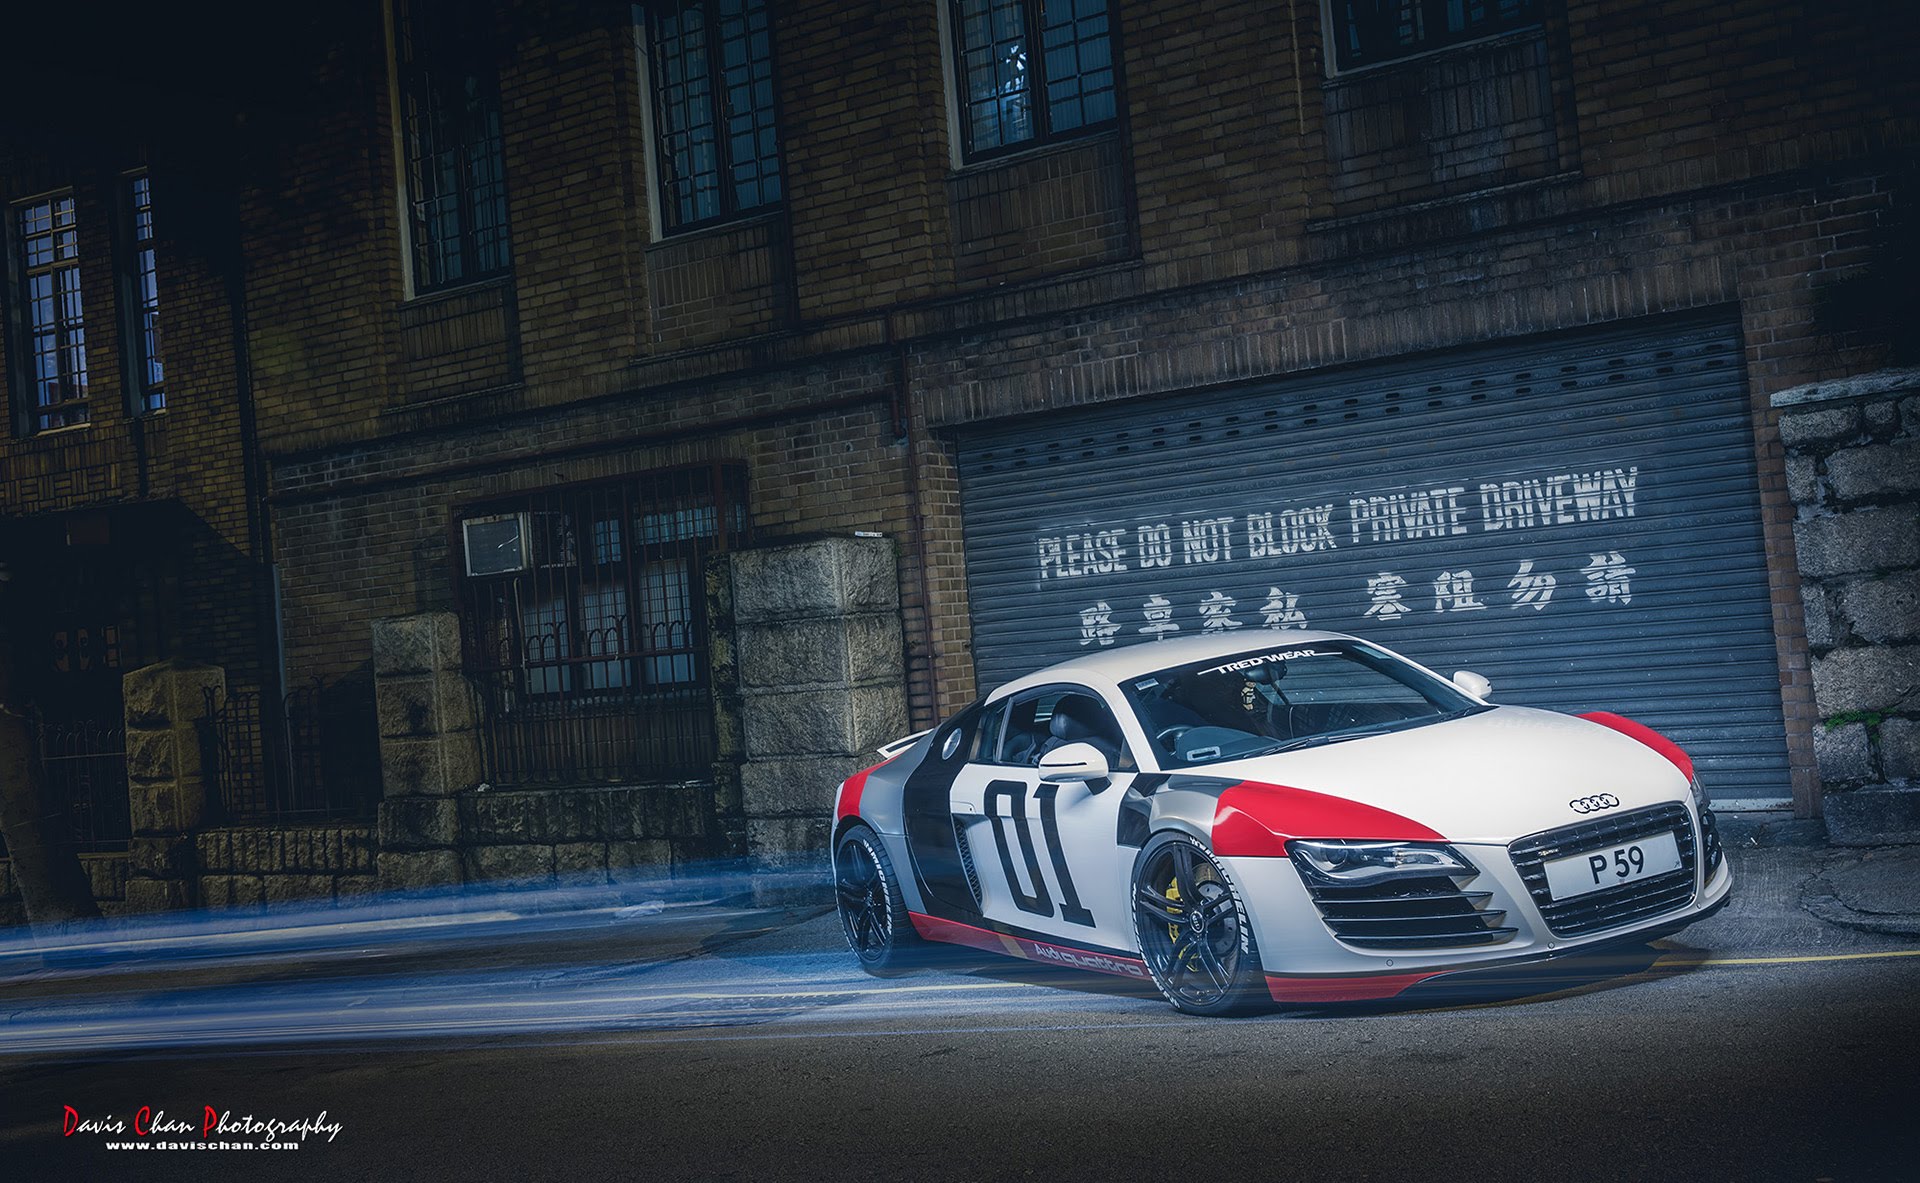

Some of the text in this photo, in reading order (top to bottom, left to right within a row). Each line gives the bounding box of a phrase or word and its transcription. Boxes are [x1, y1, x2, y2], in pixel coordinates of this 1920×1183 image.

[1038, 466, 1638, 579] PLEASE DO NOT BLOCK PRIVATE DRIVEWAY
[984, 779, 1097, 928] 01
[1589, 845, 1645, 884] P 59
[1061, 952, 1144, 977] quattro
